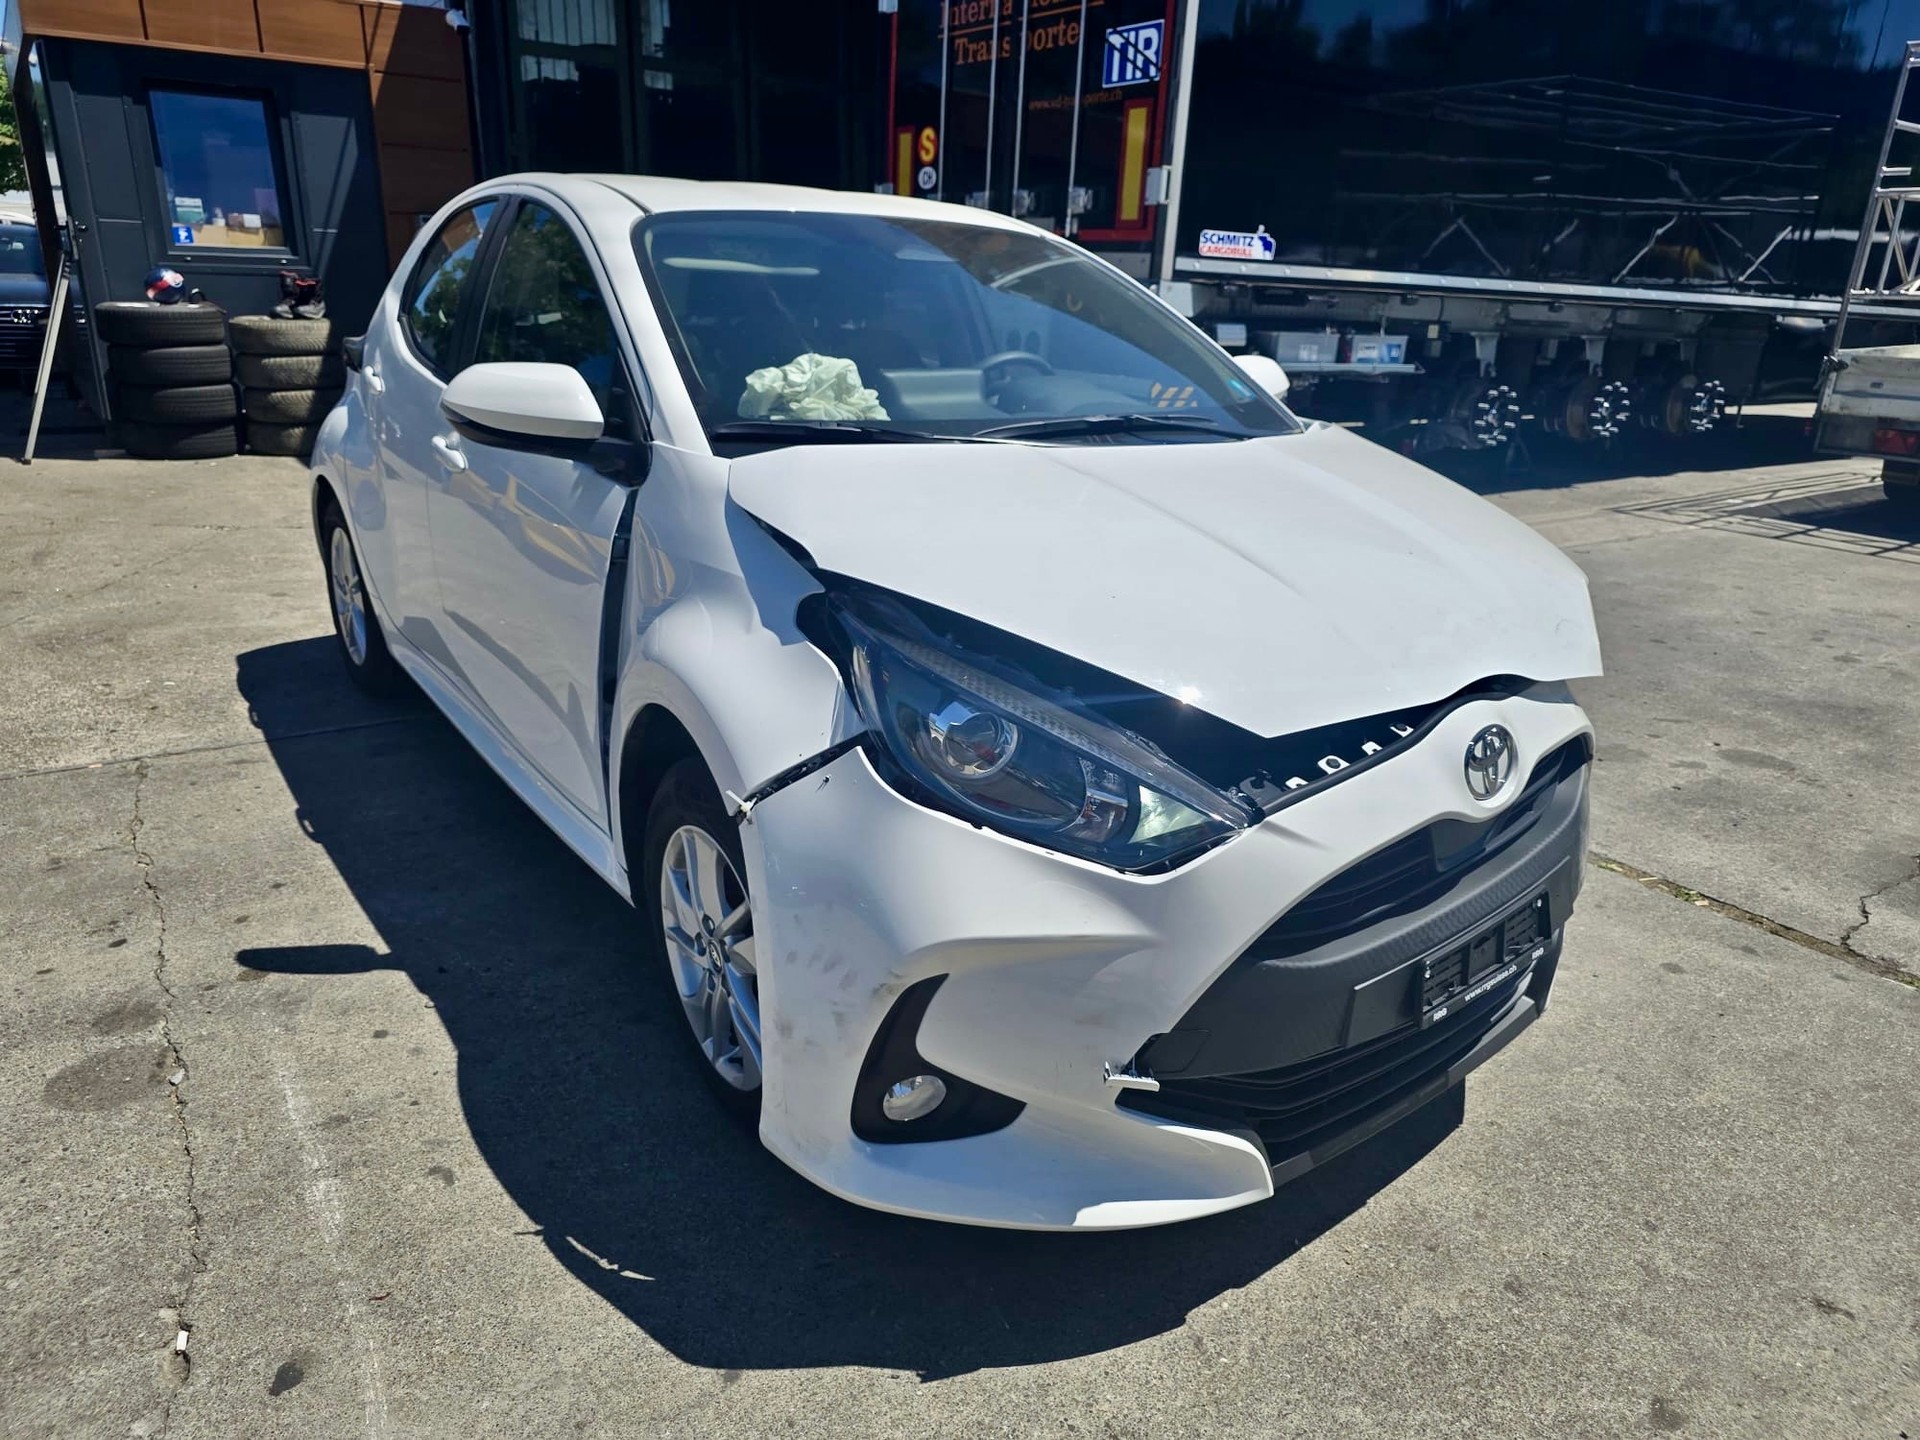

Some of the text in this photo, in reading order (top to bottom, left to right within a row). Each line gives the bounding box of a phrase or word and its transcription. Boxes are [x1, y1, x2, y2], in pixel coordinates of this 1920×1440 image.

[1107, 26, 1160, 83] TIR
[922, 127, 936, 162] S
[922, 171, 934, 185] CH
[1202, 232, 1254, 247] SCHMITZ
